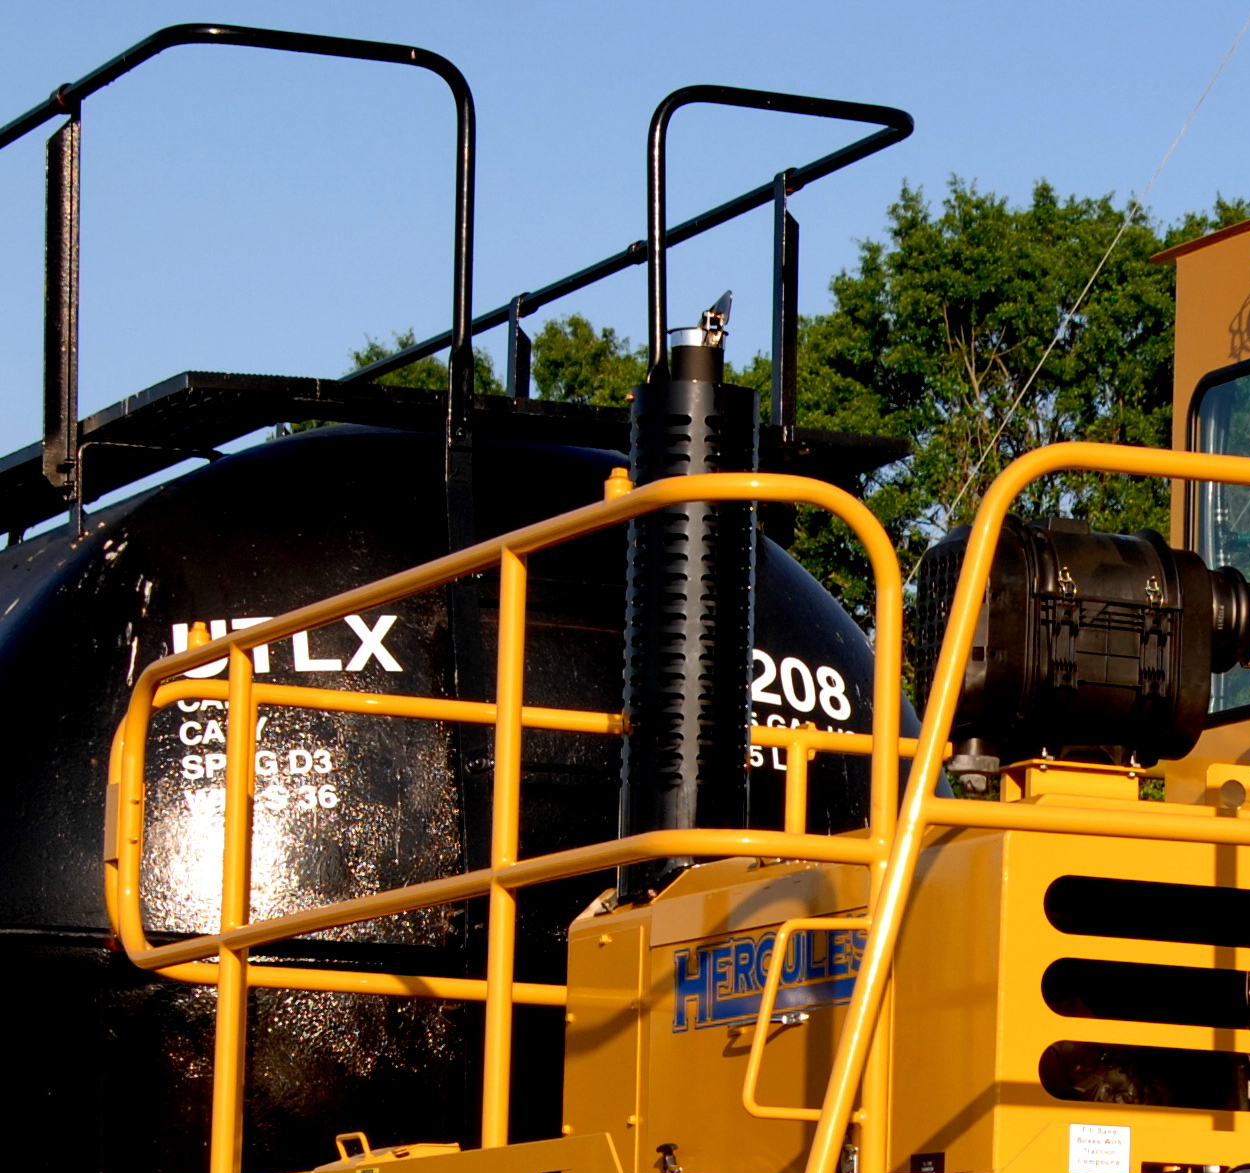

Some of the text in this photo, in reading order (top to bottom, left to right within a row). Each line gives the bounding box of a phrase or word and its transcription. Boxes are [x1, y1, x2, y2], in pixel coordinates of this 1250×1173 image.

[172, 614, 403, 679] UTLX
[181, 749, 333, 780] SPG D3
[298, 784, 339, 809] 36
